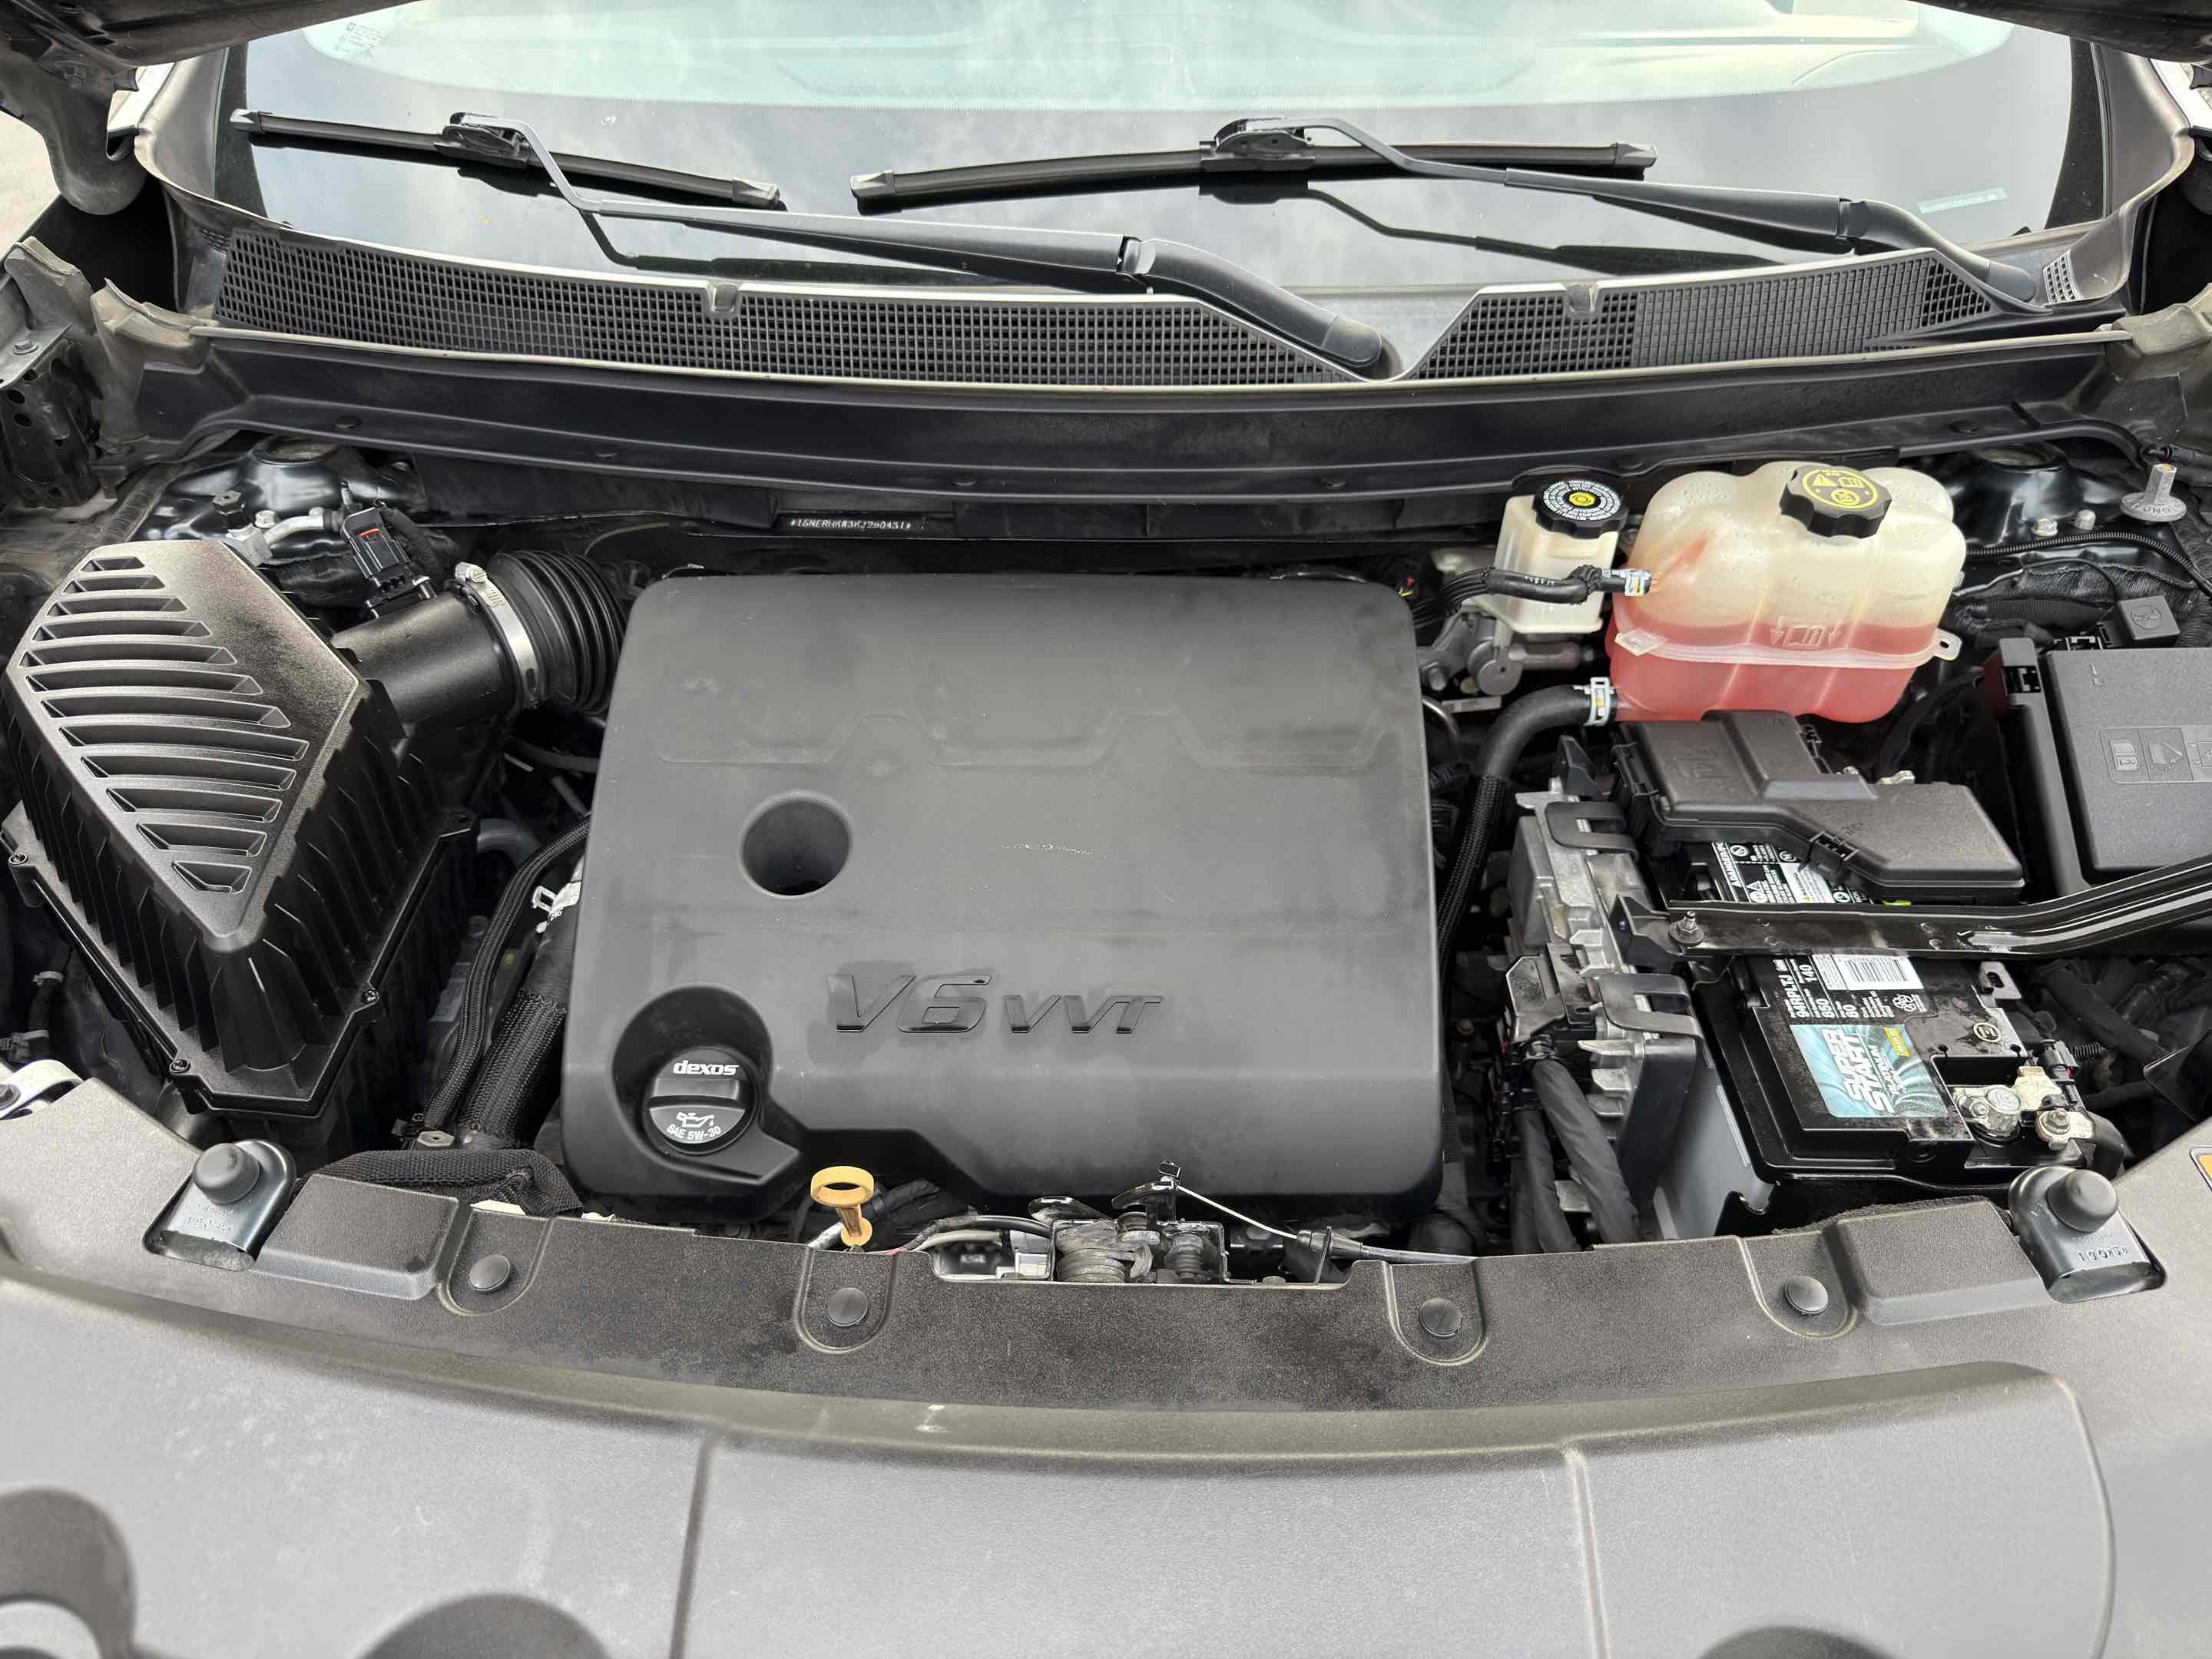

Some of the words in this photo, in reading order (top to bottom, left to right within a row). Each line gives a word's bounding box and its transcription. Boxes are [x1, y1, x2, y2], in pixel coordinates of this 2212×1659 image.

[1799, 964, 1817, 982] 140
[827, 973, 992, 1033] V6
[1002, 995, 1164, 1034] VVT
[1815, 998, 1835, 1018] 850
[673, 1060, 740, 1076] dexos
[1820, 1028, 1865, 1101] SUPER
[1843, 1035, 1896, 1113] START
[667, 1124, 685, 1140] SAE
[687, 1125, 722, 1141] 5W-30
